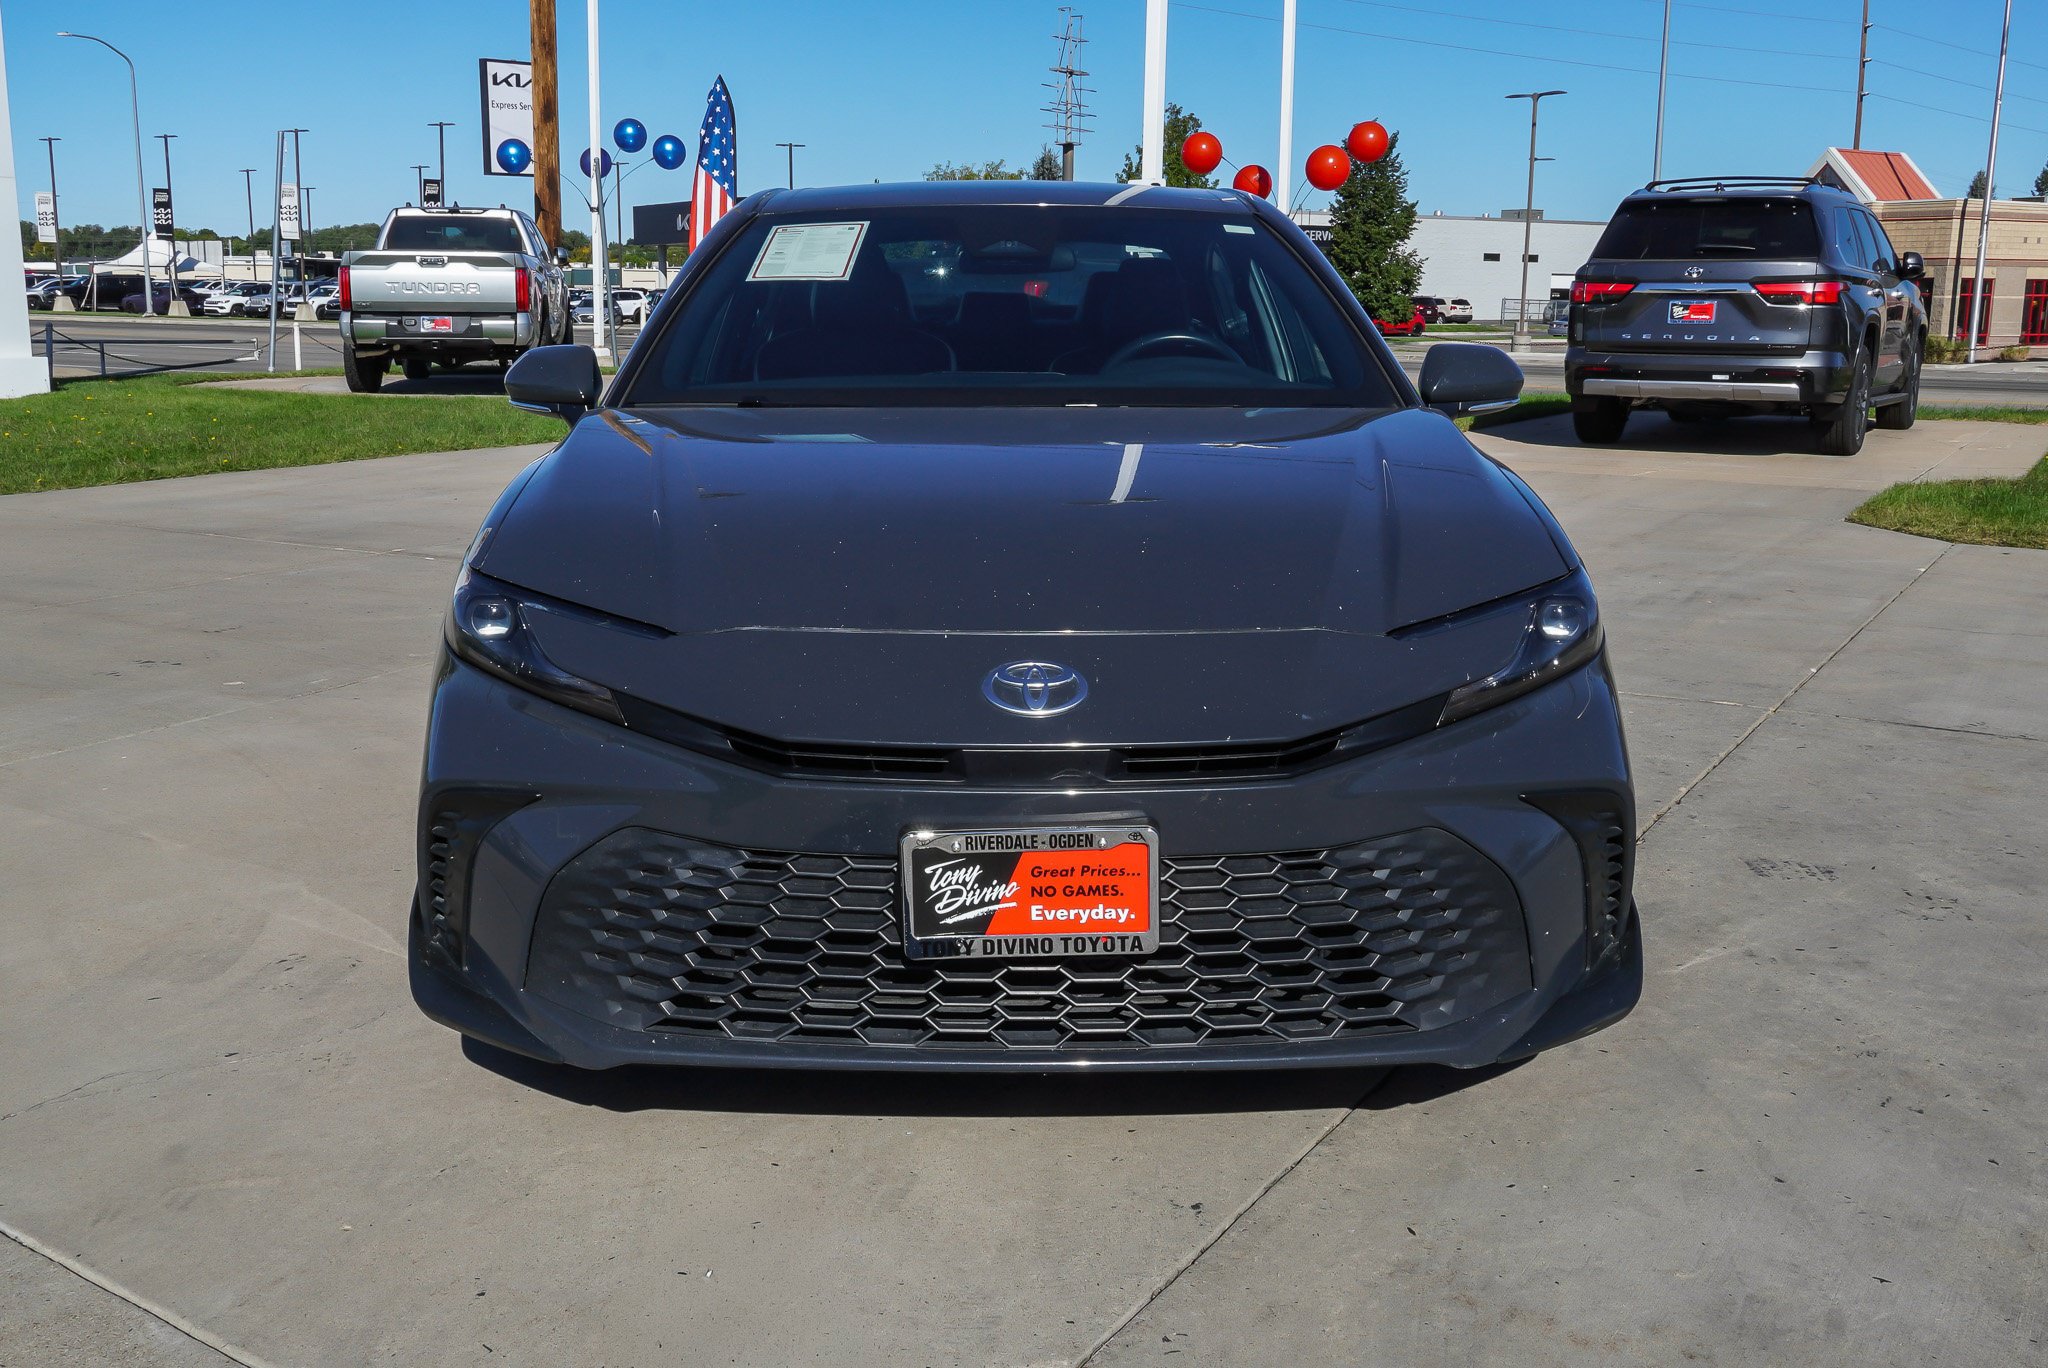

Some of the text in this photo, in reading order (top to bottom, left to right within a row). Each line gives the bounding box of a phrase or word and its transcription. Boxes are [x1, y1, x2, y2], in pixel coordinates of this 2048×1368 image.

[491, 100, 518, 111] Express
[384, 281, 481, 295] TUNDRA
[965, 834, 1038, 850] RIVERDALE
[1049, 833, 1094, 848] OGDEN
[924, 857, 983, 891] Tony
[1030, 864, 1141, 878] Great Prices...
[925, 879, 1021, 914] Divino
[1030, 884, 1124, 897] NO GAMES.
[1030, 904, 1135, 924] Everyday.
[982, 937, 1054, 955] DIVINO
[1060, 935, 1144, 954] TOYOTA
